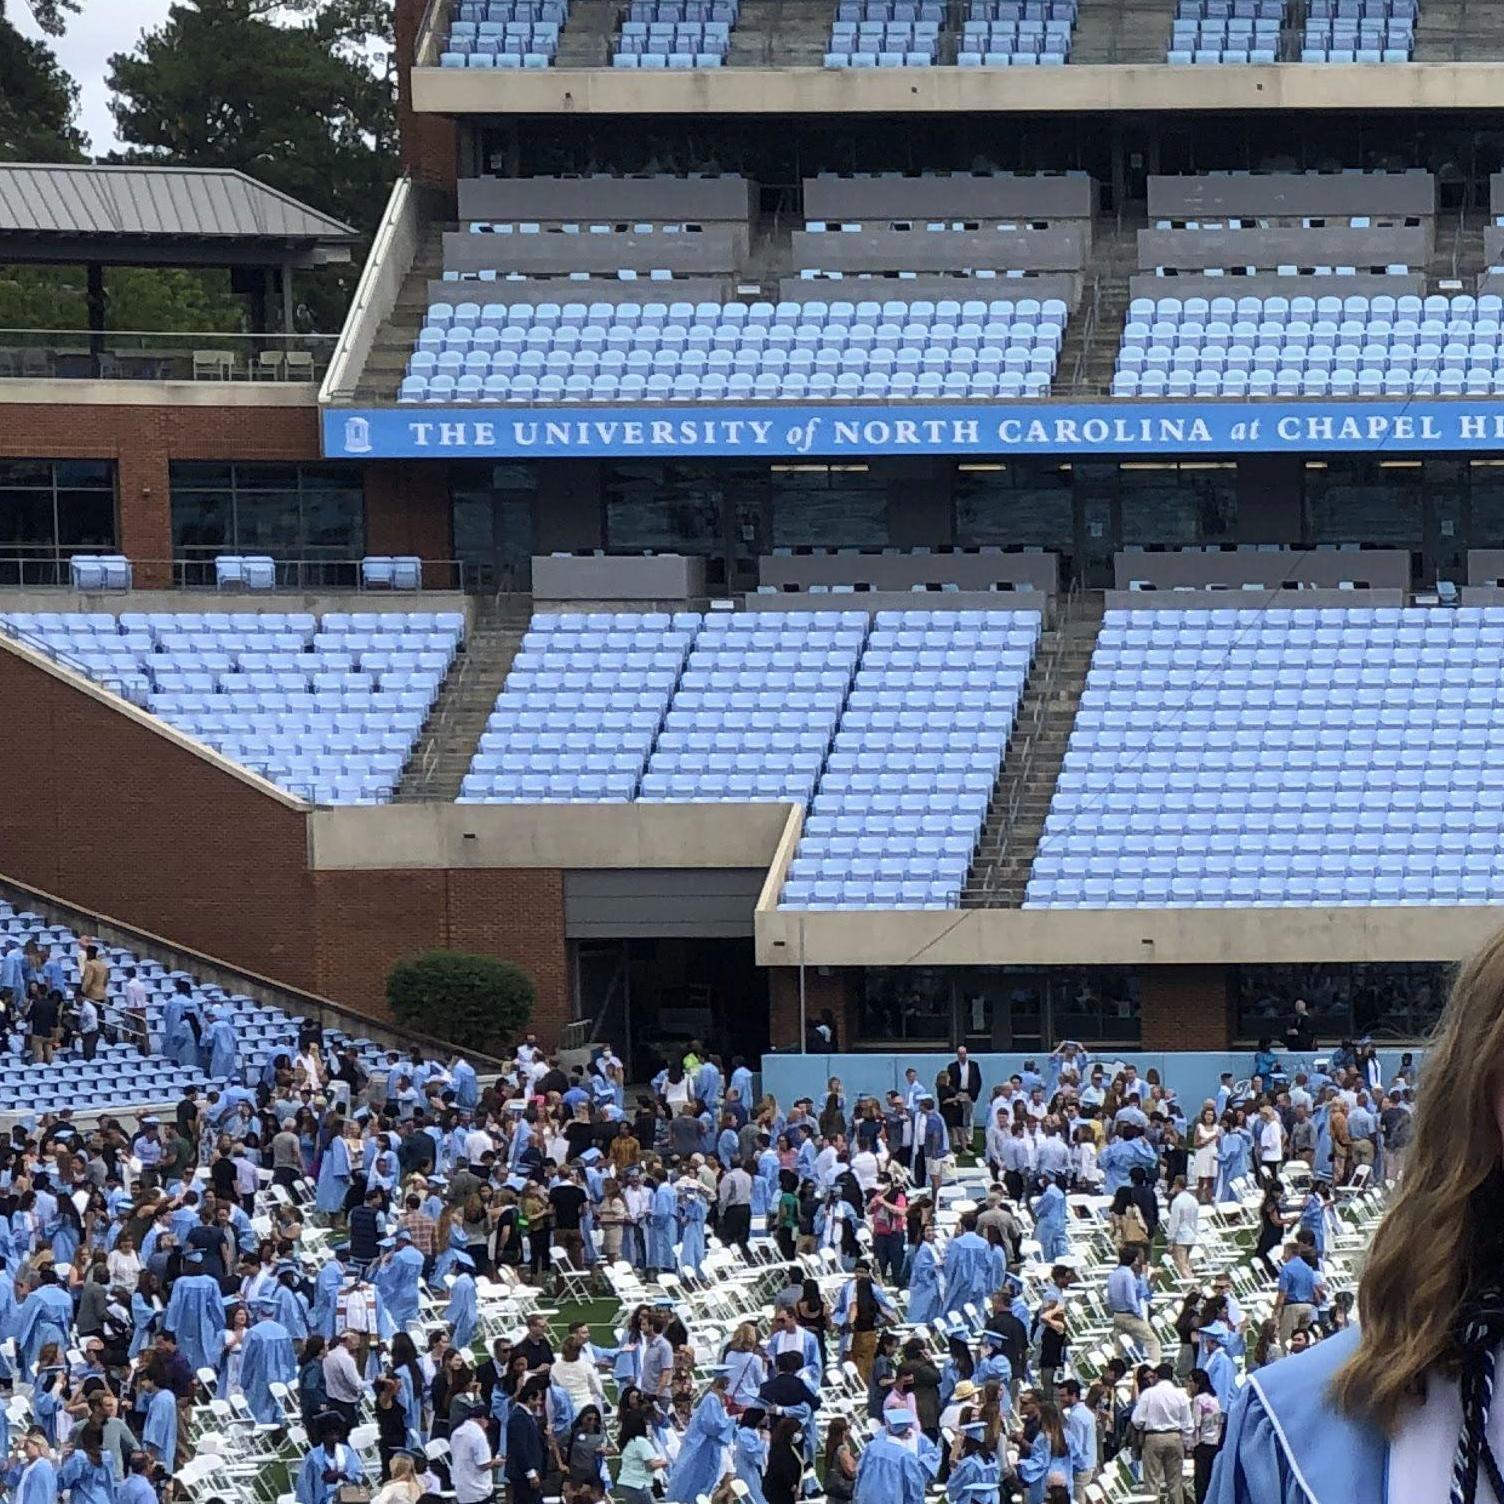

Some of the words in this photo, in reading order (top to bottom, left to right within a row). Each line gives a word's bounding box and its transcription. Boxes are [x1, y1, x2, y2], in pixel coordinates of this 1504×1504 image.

[409, 422, 495, 446] THE
[513, 420, 772, 446] UNIVERSITY
[785, 417, 821, 452] of
[834, 419, 979, 445] NORTH
[998, 417, 1213, 444] CAROLINA
[1230, 418, 1261, 441] at
[1276, 415, 1442, 441] CHAPEL
